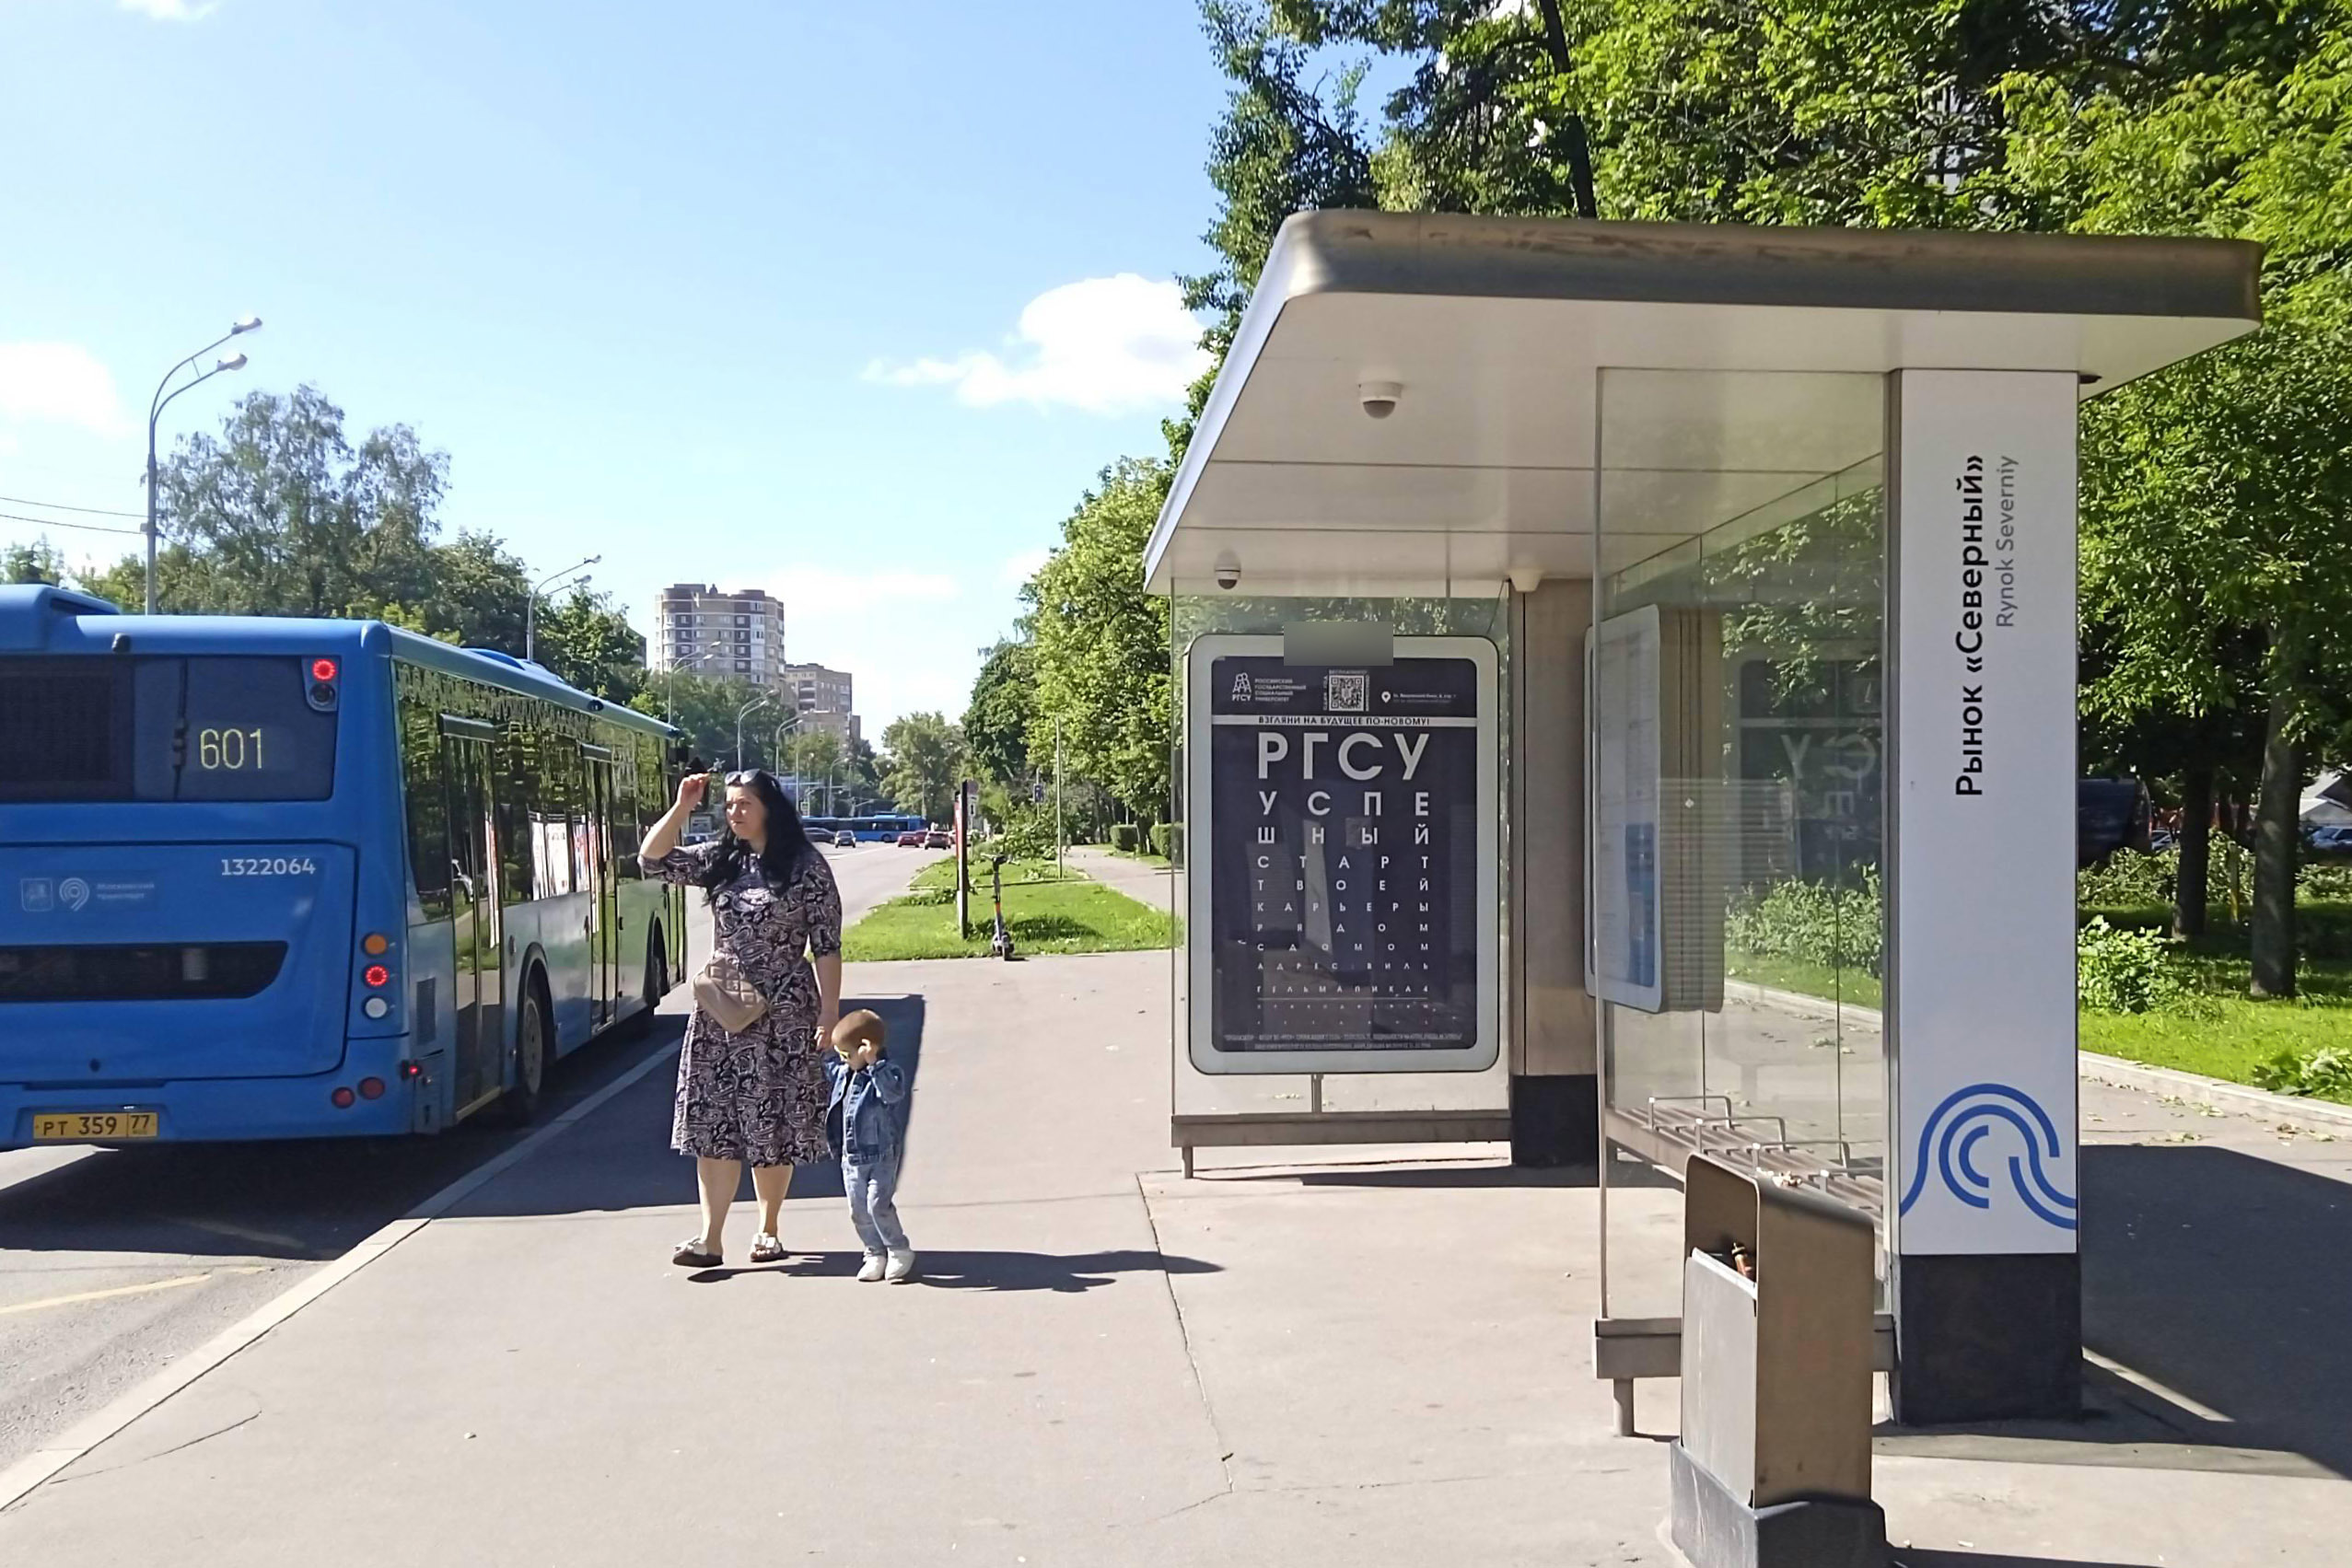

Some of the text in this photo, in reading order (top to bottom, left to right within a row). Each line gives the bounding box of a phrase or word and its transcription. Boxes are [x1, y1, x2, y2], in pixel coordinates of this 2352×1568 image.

[1995, 455, 2019, 627] Rynok Severniy
[1955, 455, 1989, 796] Рынок «Северный»
[1258, 716, 1300, 725] ВЗГЛЯНИ
[1303, 716, 1317, 725] НА
[1320, 716, 1363, 726] БУДУЩЕЕ
[200, 728, 262, 770] 601
[1258, 732, 1430, 781] РГСУ
[221, 858, 316, 877] 1322064
[78, 1116, 117, 1135] 359
[131, 1115, 150, 1130] 77
